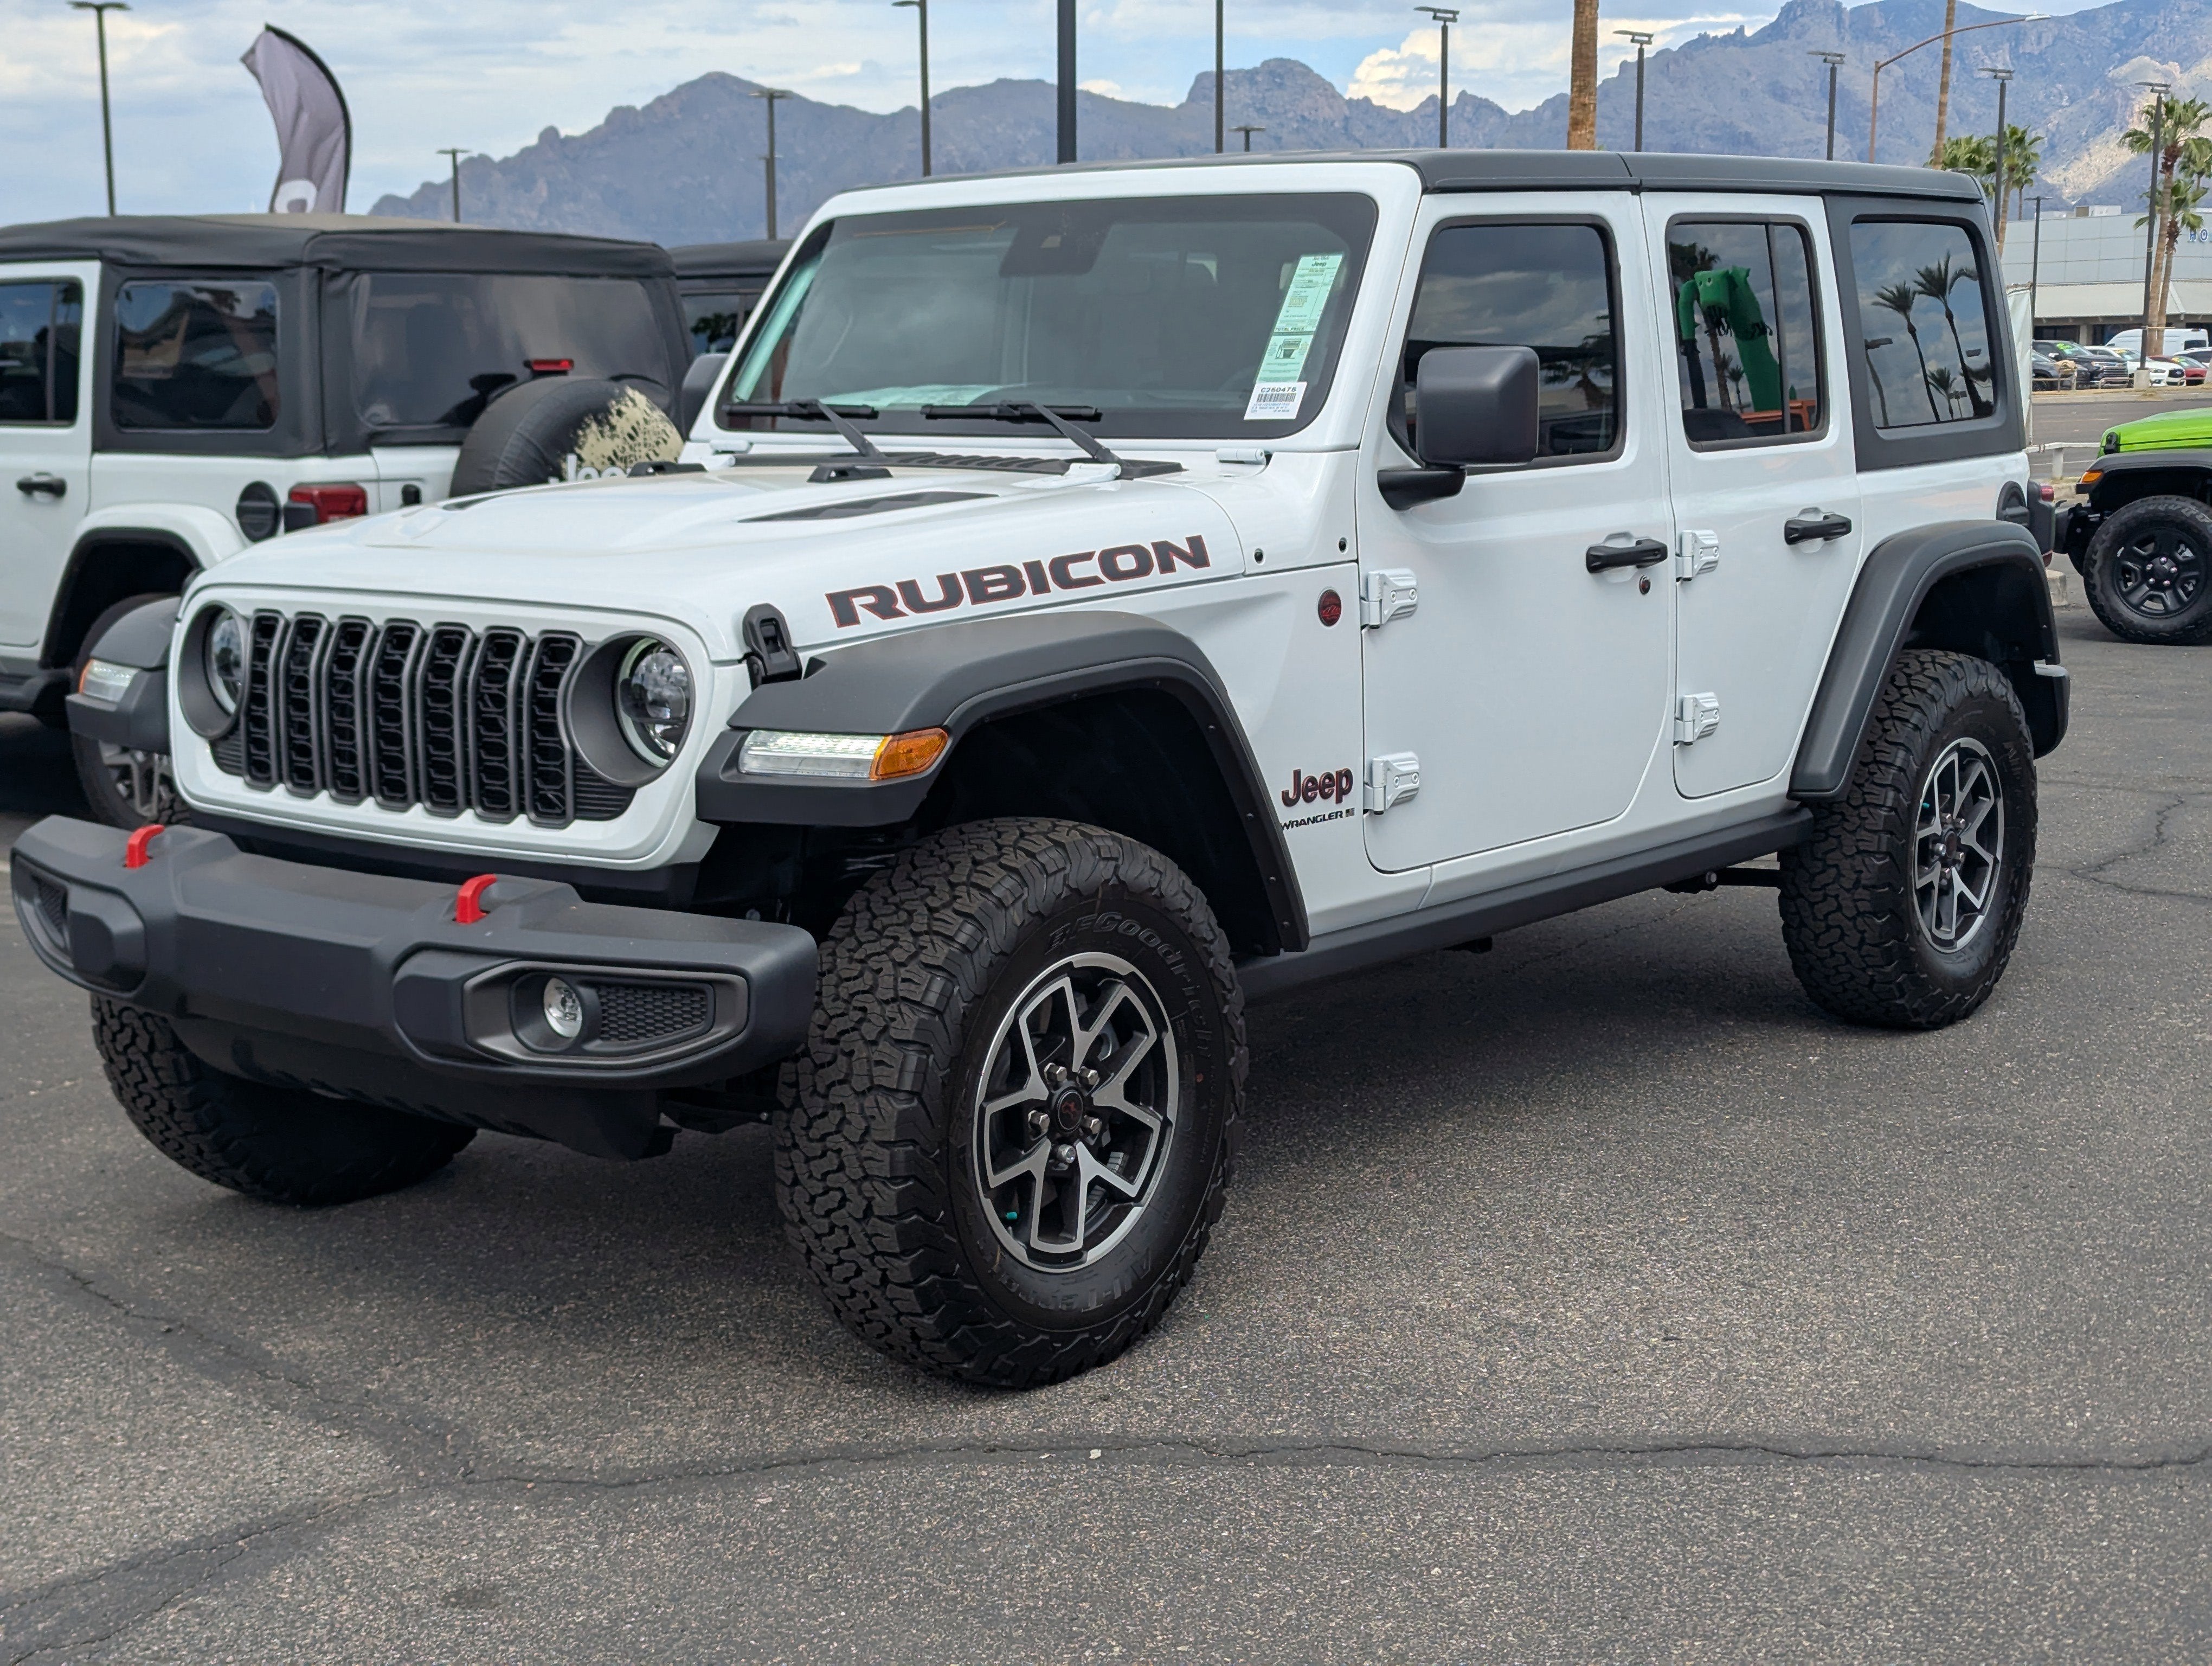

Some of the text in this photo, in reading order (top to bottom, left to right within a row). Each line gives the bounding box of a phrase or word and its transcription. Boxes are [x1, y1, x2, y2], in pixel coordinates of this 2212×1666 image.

[824, 534, 1211, 629] RUBICON
[1281, 767, 1354, 808] Jeep
[1280, 810, 1344, 831] WRANGLER
